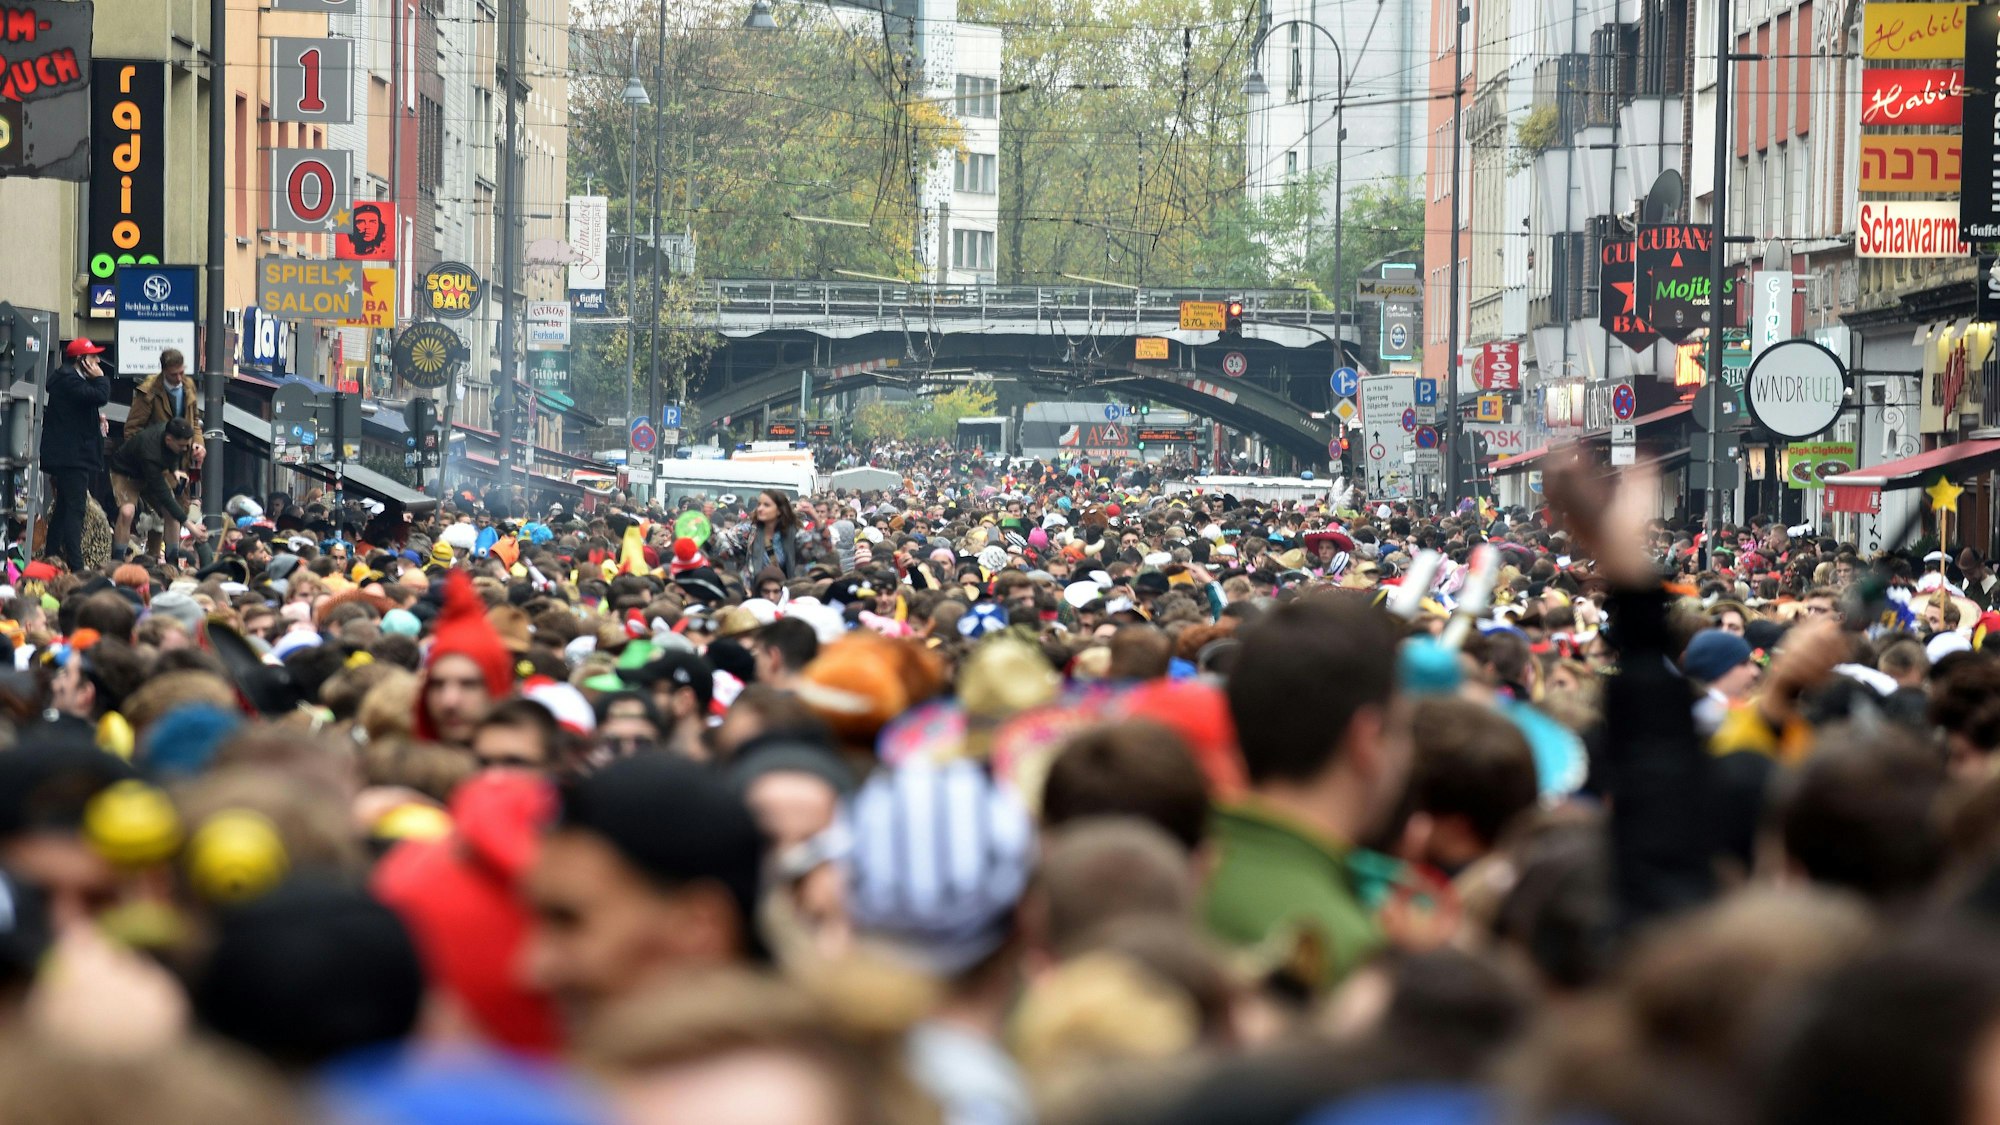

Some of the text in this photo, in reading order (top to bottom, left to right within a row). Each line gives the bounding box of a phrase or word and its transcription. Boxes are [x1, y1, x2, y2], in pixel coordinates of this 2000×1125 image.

[1866, 6, 1964, 56] Habib
[297, 47, 326, 113] 1
[1863, 71, 1962, 122] Habib
[112, 65, 141, 249] radio
[265, 263, 336, 286] SPIEL
[426, 273, 478, 292] SOUL
[432, 292, 471, 310] BAR
[1656, 276, 1734, 302] Mojits
[265, 291, 350, 314] SALON
[533, 306, 564, 317] GYROS
[1490, 343, 1513, 389] KIOSK
[1812, 446, 1854, 455] Cigköfte
